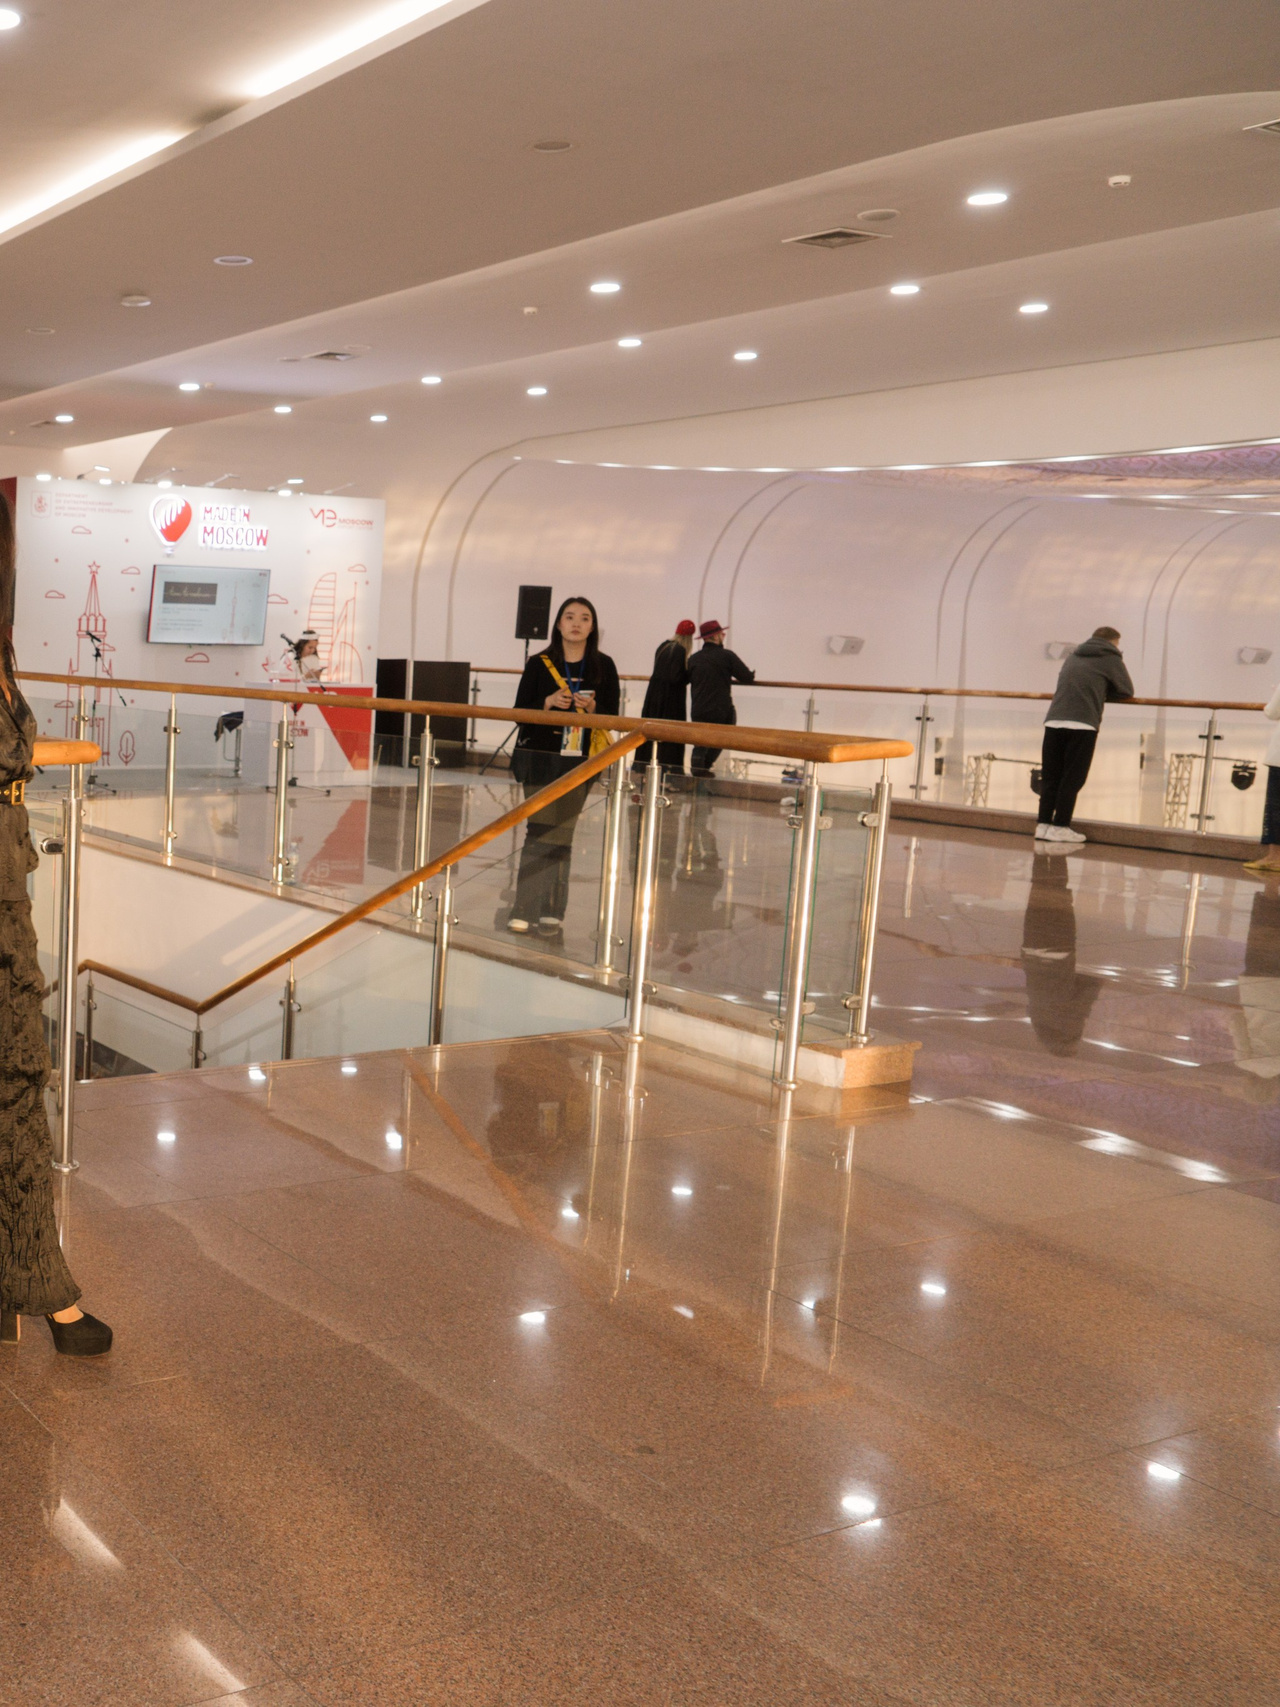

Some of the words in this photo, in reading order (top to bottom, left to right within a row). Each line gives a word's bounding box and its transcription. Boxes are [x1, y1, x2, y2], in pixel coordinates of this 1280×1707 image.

[203, 505, 237, 523] MADE
[238, 507, 251, 523] IN
[338, 517, 374, 526] MOSCOW
[202, 526, 269, 547] MOSCOW
